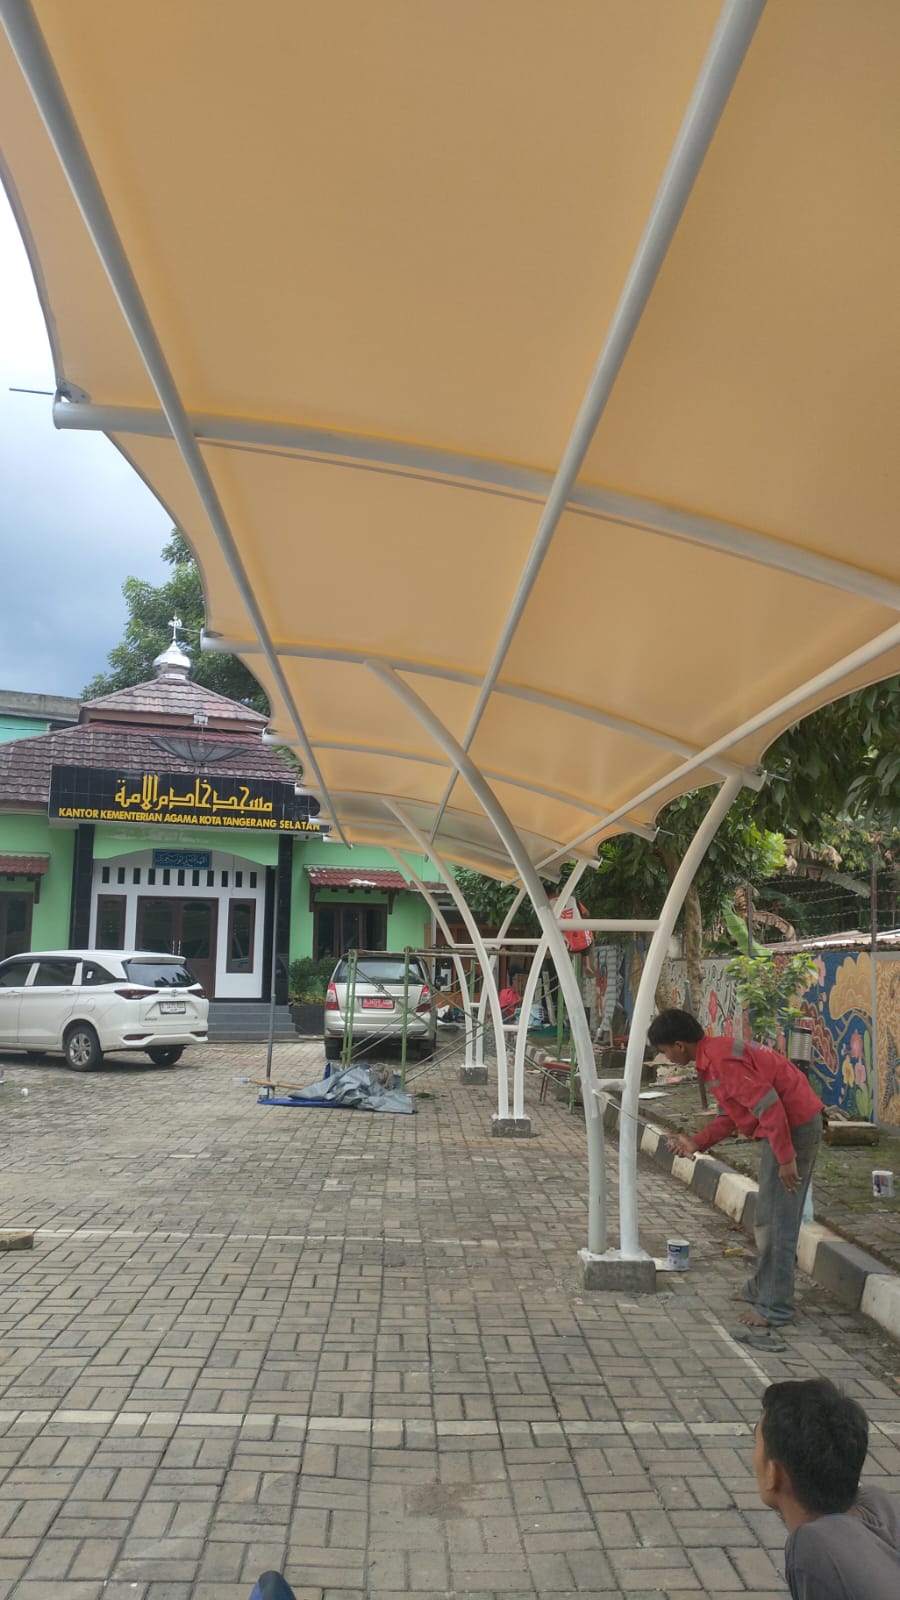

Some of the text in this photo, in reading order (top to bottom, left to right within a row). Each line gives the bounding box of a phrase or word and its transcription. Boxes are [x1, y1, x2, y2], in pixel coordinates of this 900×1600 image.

[153, 777, 212, 810] خادم
[212, 786, 273, 814] مسجد
[58, 807, 99, 818] KANTOR
[100, 809, 162, 822] KEMENTERIAN
[164, 813, 198, 824] AGAMA
[199, 815, 221, 826] KOTA
[222, 816, 277, 828] TANGERANG
